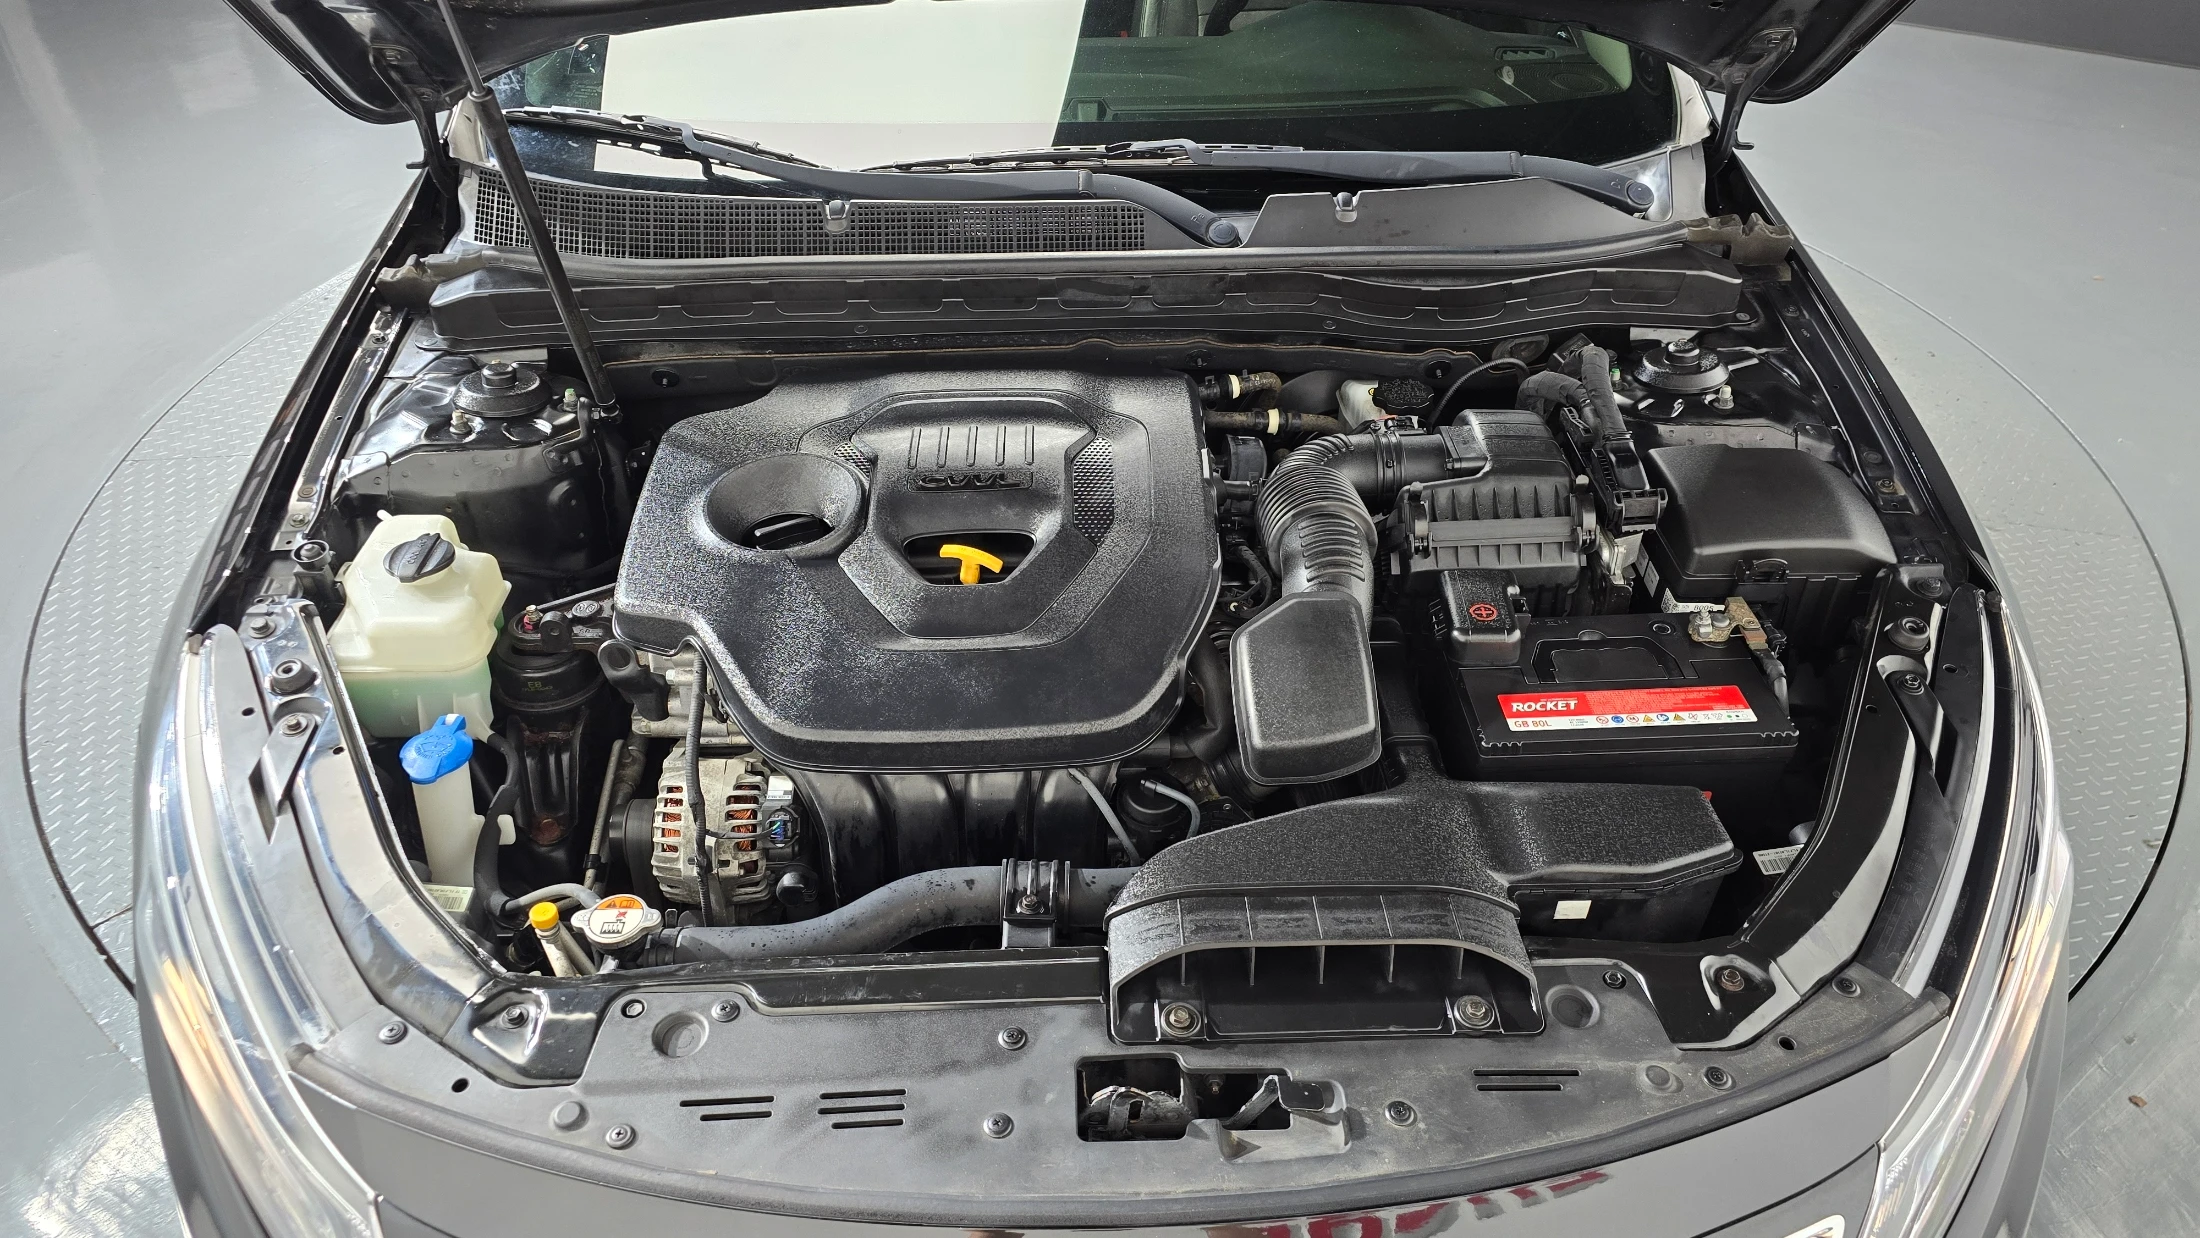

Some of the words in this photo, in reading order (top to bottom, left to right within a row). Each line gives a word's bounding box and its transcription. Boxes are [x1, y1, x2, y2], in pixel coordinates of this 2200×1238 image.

[1511, 700, 1578, 713] ROCKET
[1514, 720, 1529, 728] GB
[1532, 719, 1552, 727] 80L
